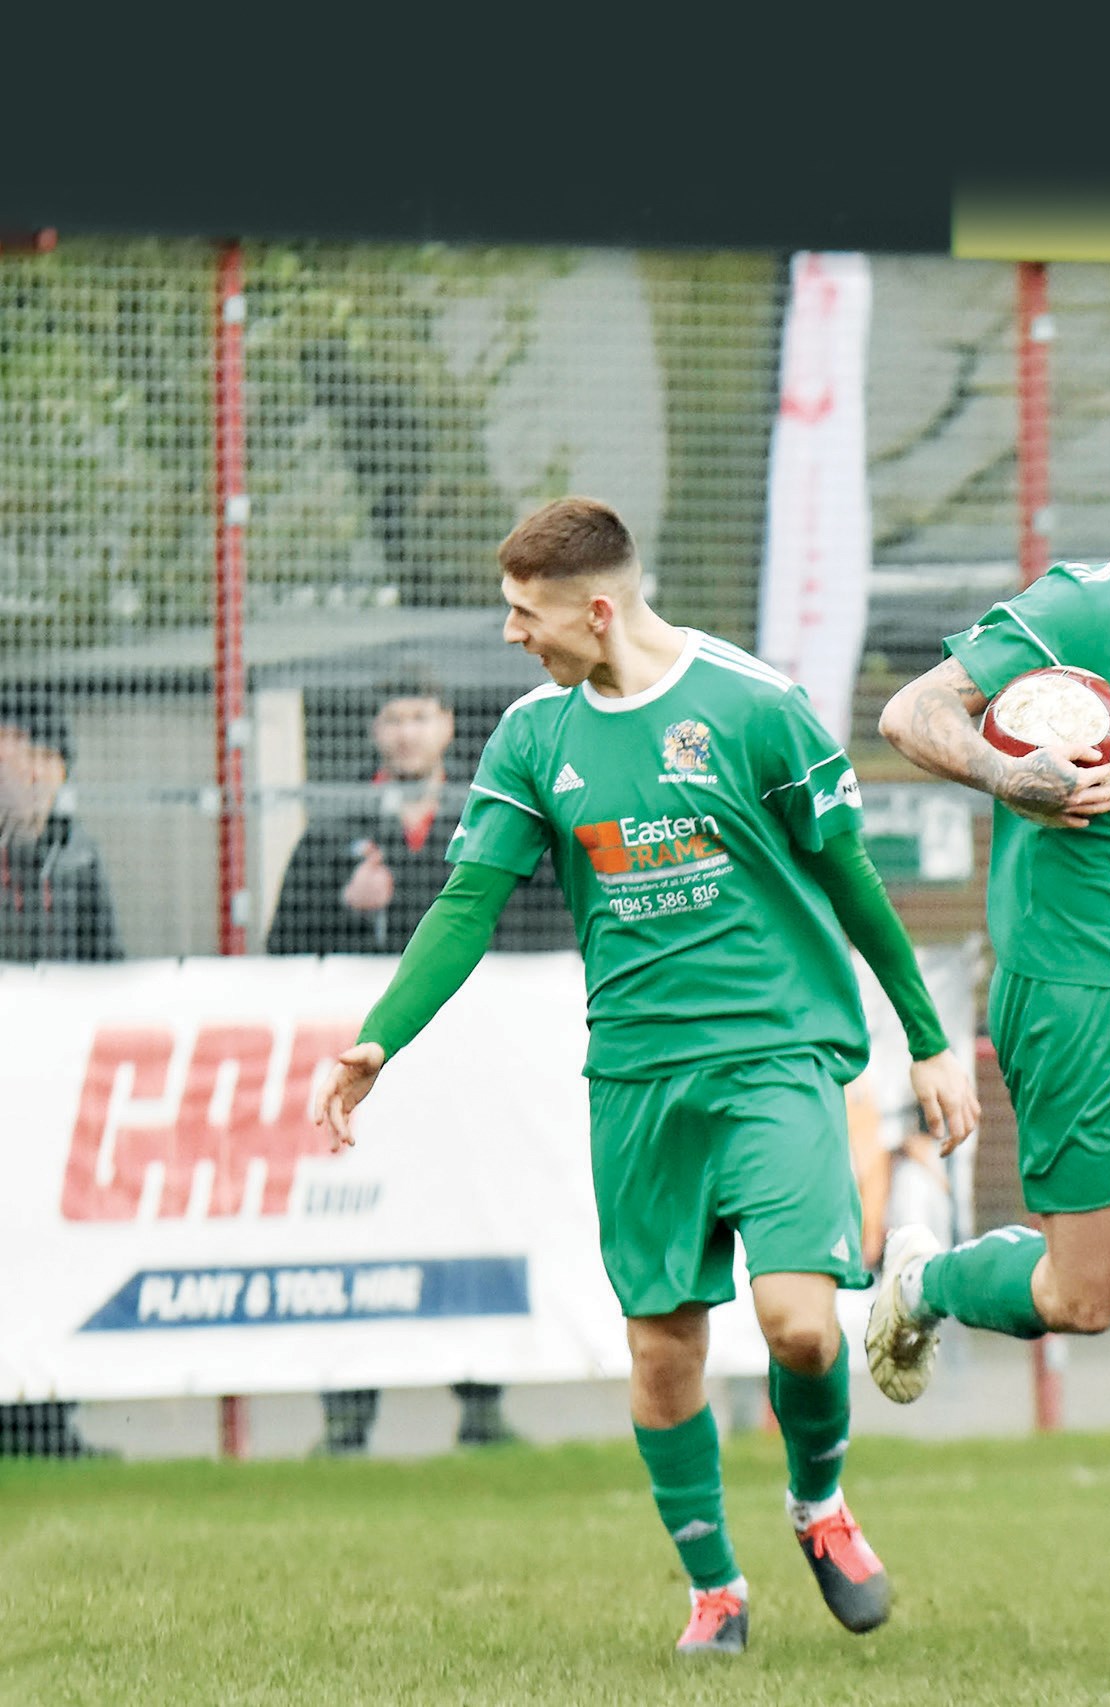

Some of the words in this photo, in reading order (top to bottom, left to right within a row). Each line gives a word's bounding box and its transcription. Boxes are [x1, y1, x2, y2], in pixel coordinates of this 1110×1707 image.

[619, 814, 720, 847] Eastern
[609, 895, 653, 916] 01945
[656, 889, 688, 910] 586
[691, 882, 720, 902] 816
[137, 1272, 245, 1322] PLANT
[274, 1268, 350, 1317] TOOL
